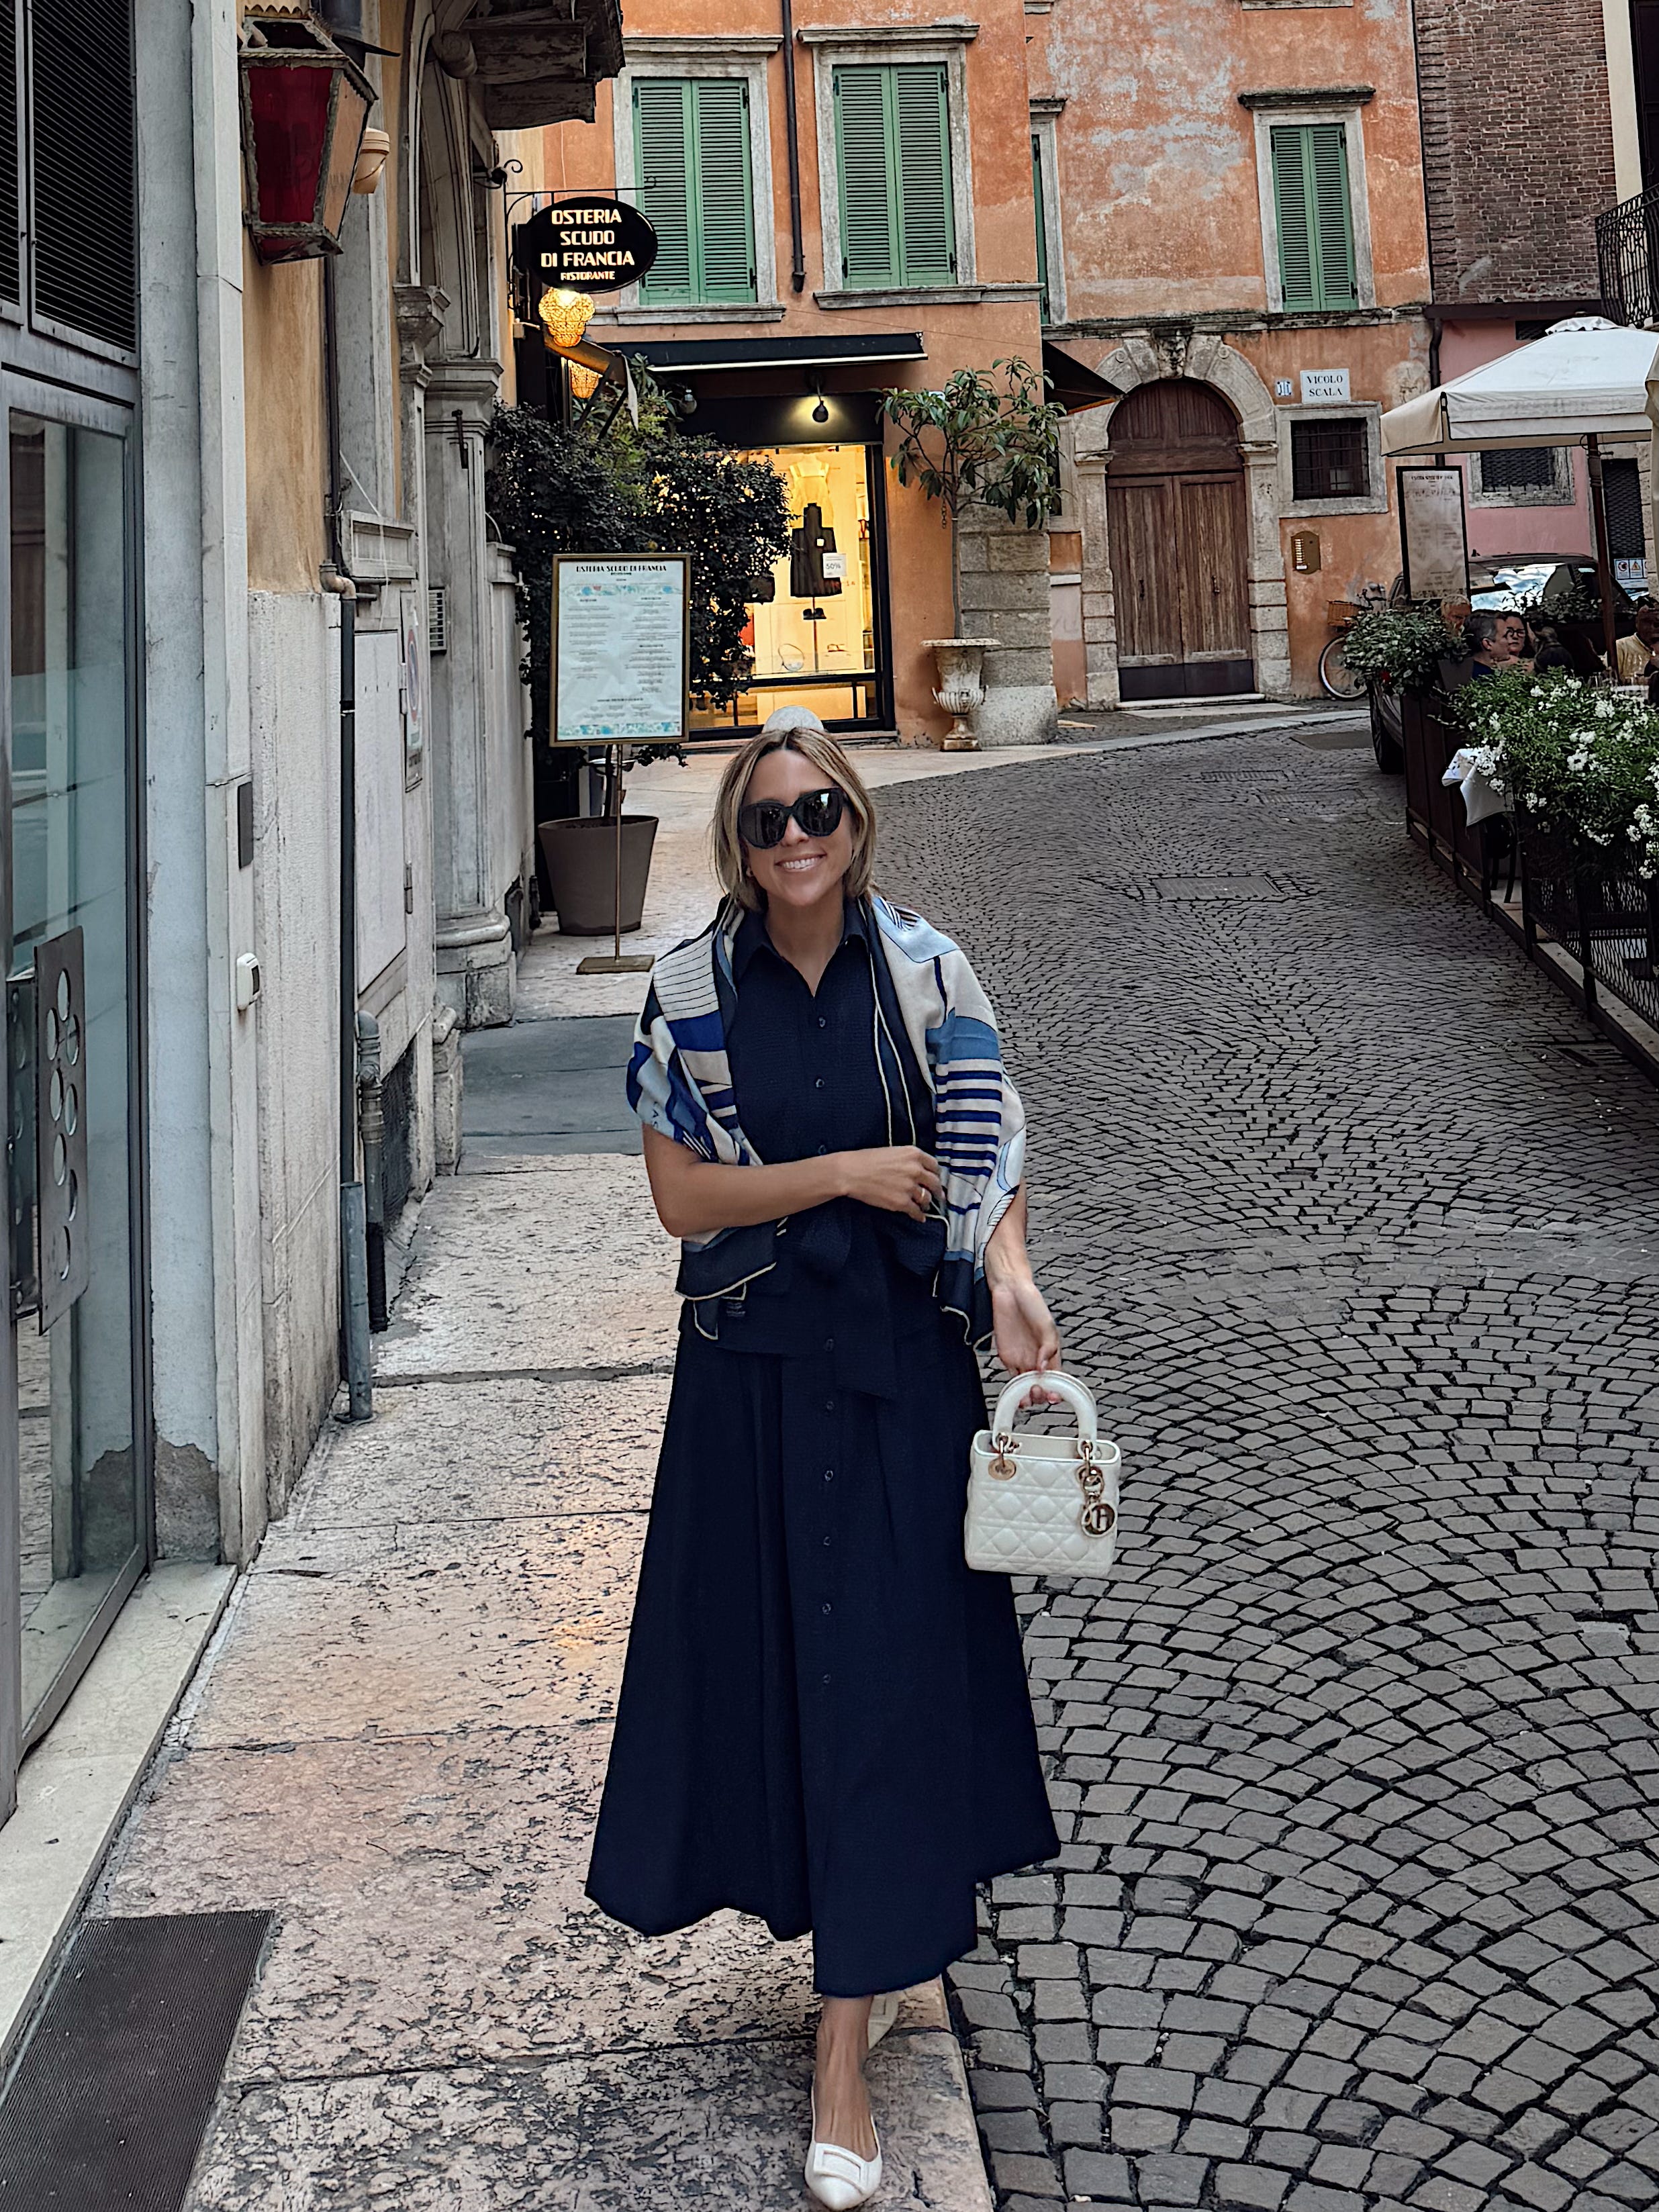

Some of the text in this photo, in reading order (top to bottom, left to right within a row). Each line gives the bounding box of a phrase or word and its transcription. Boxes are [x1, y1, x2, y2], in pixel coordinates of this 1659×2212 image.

[551, 209, 622, 225] OSTERIA
[560, 230, 615, 246] SCUDO
[540, 250, 635, 268] DI FRANCIA
[560, 271, 616, 281] RISTORANTE
[1307, 375, 1343, 383] VICOLO
[1309, 387, 1342, 397] SCALA
